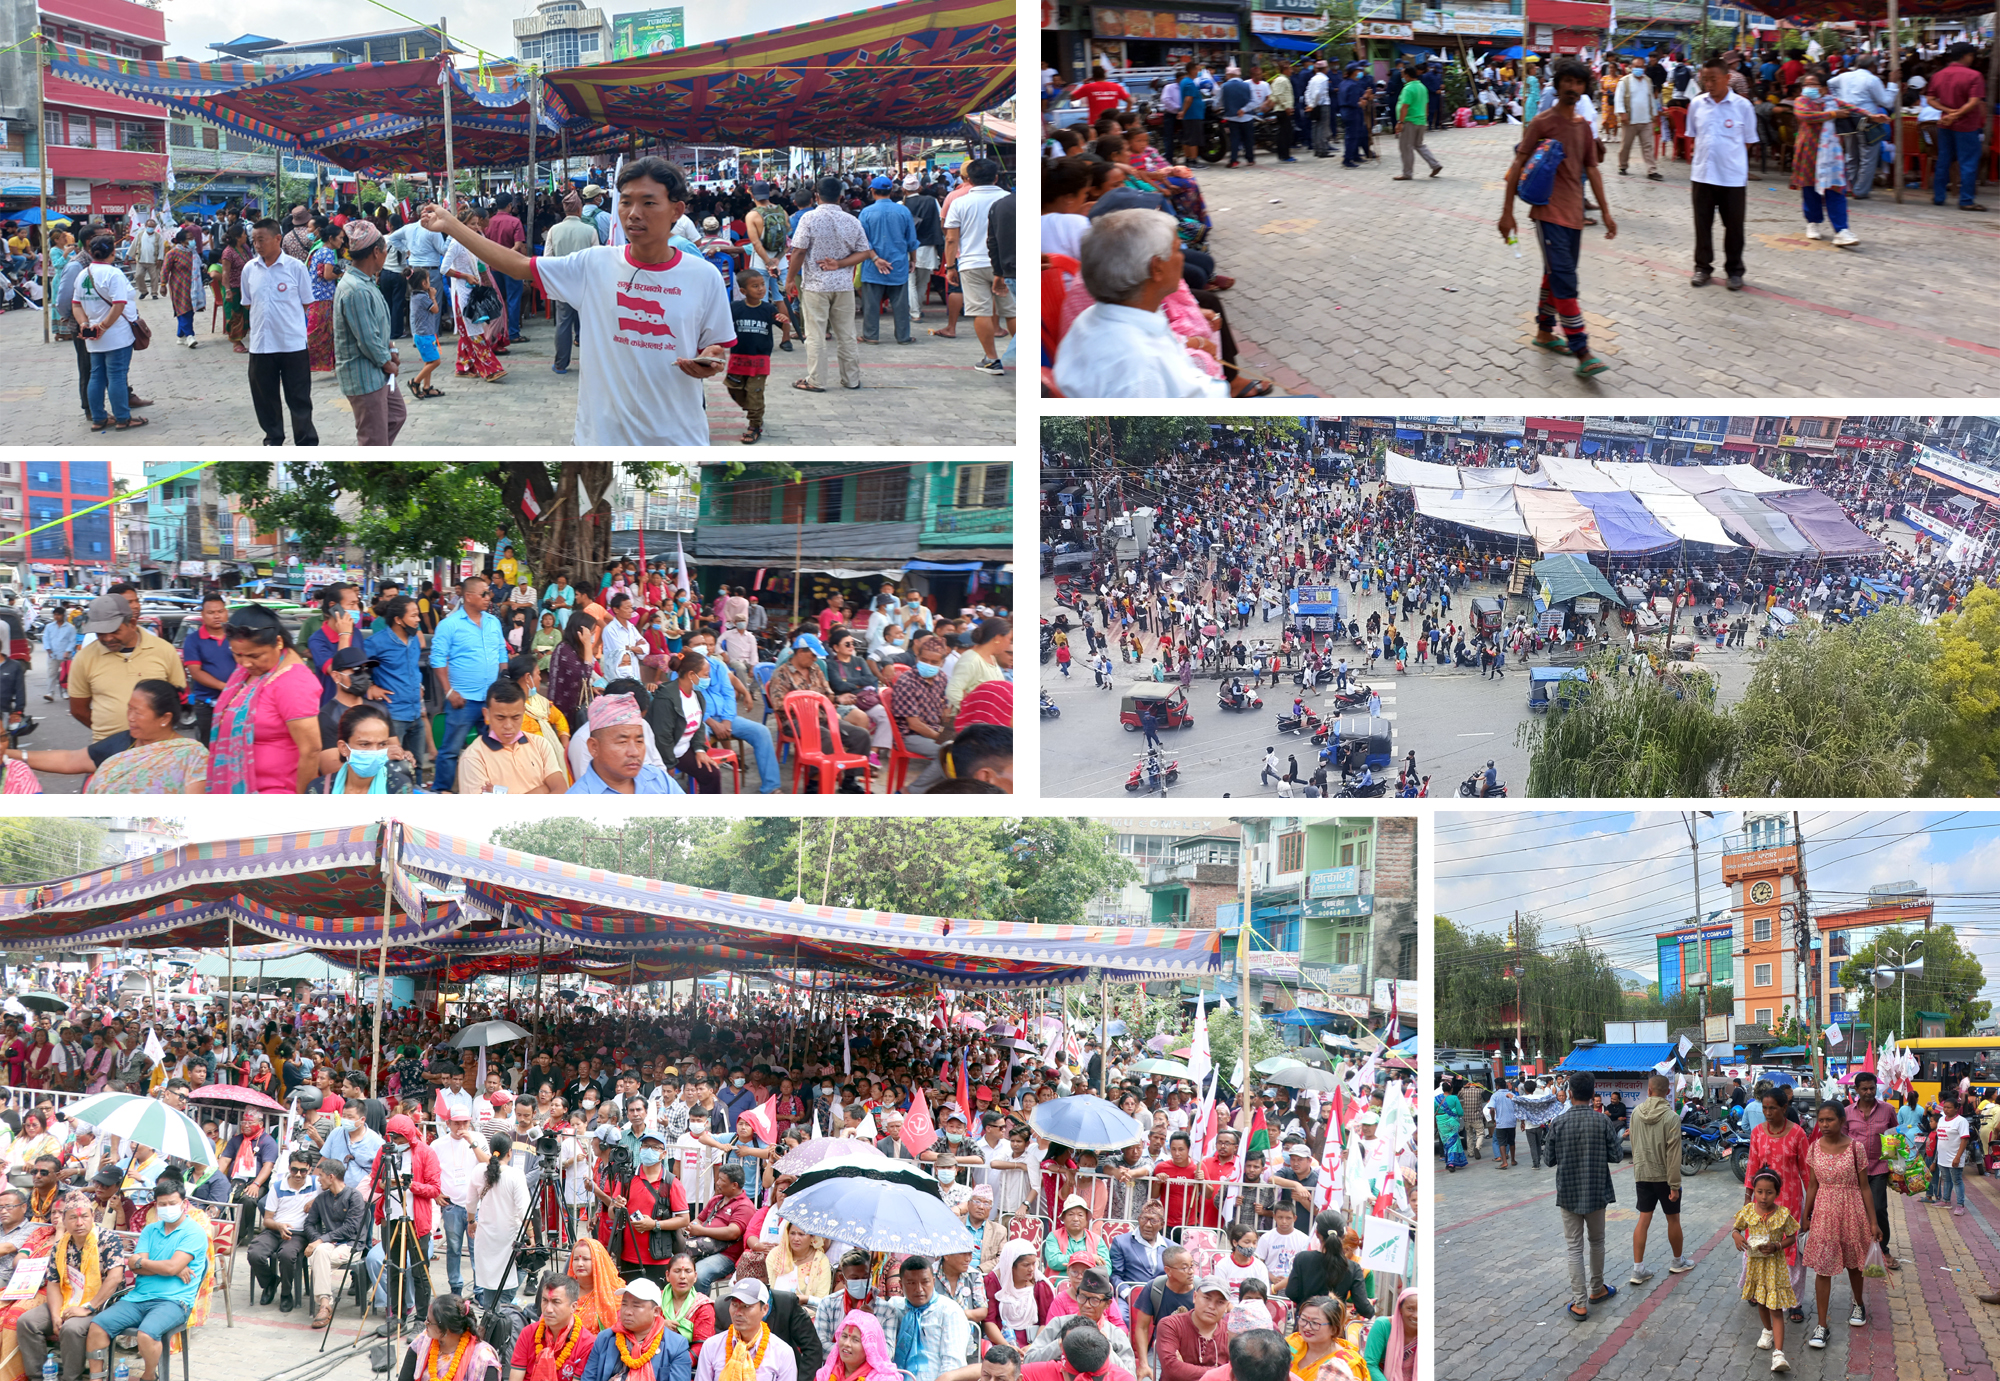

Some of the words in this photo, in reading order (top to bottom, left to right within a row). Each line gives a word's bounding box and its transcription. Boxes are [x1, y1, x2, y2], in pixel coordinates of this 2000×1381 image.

[647, 17, 673, 26] TUBORG
[101, 205, 125, 213] TUBORG
[1139, 819, 1211, 830] COMPLEX
[1315, 871, 1348, 884] सत्कार
[1684, 933, 1705, 941] GORKA
[1707, 930, 1730, 938] COMPLEX
[1620, 1090, 1641, 1101] ोजपुर
